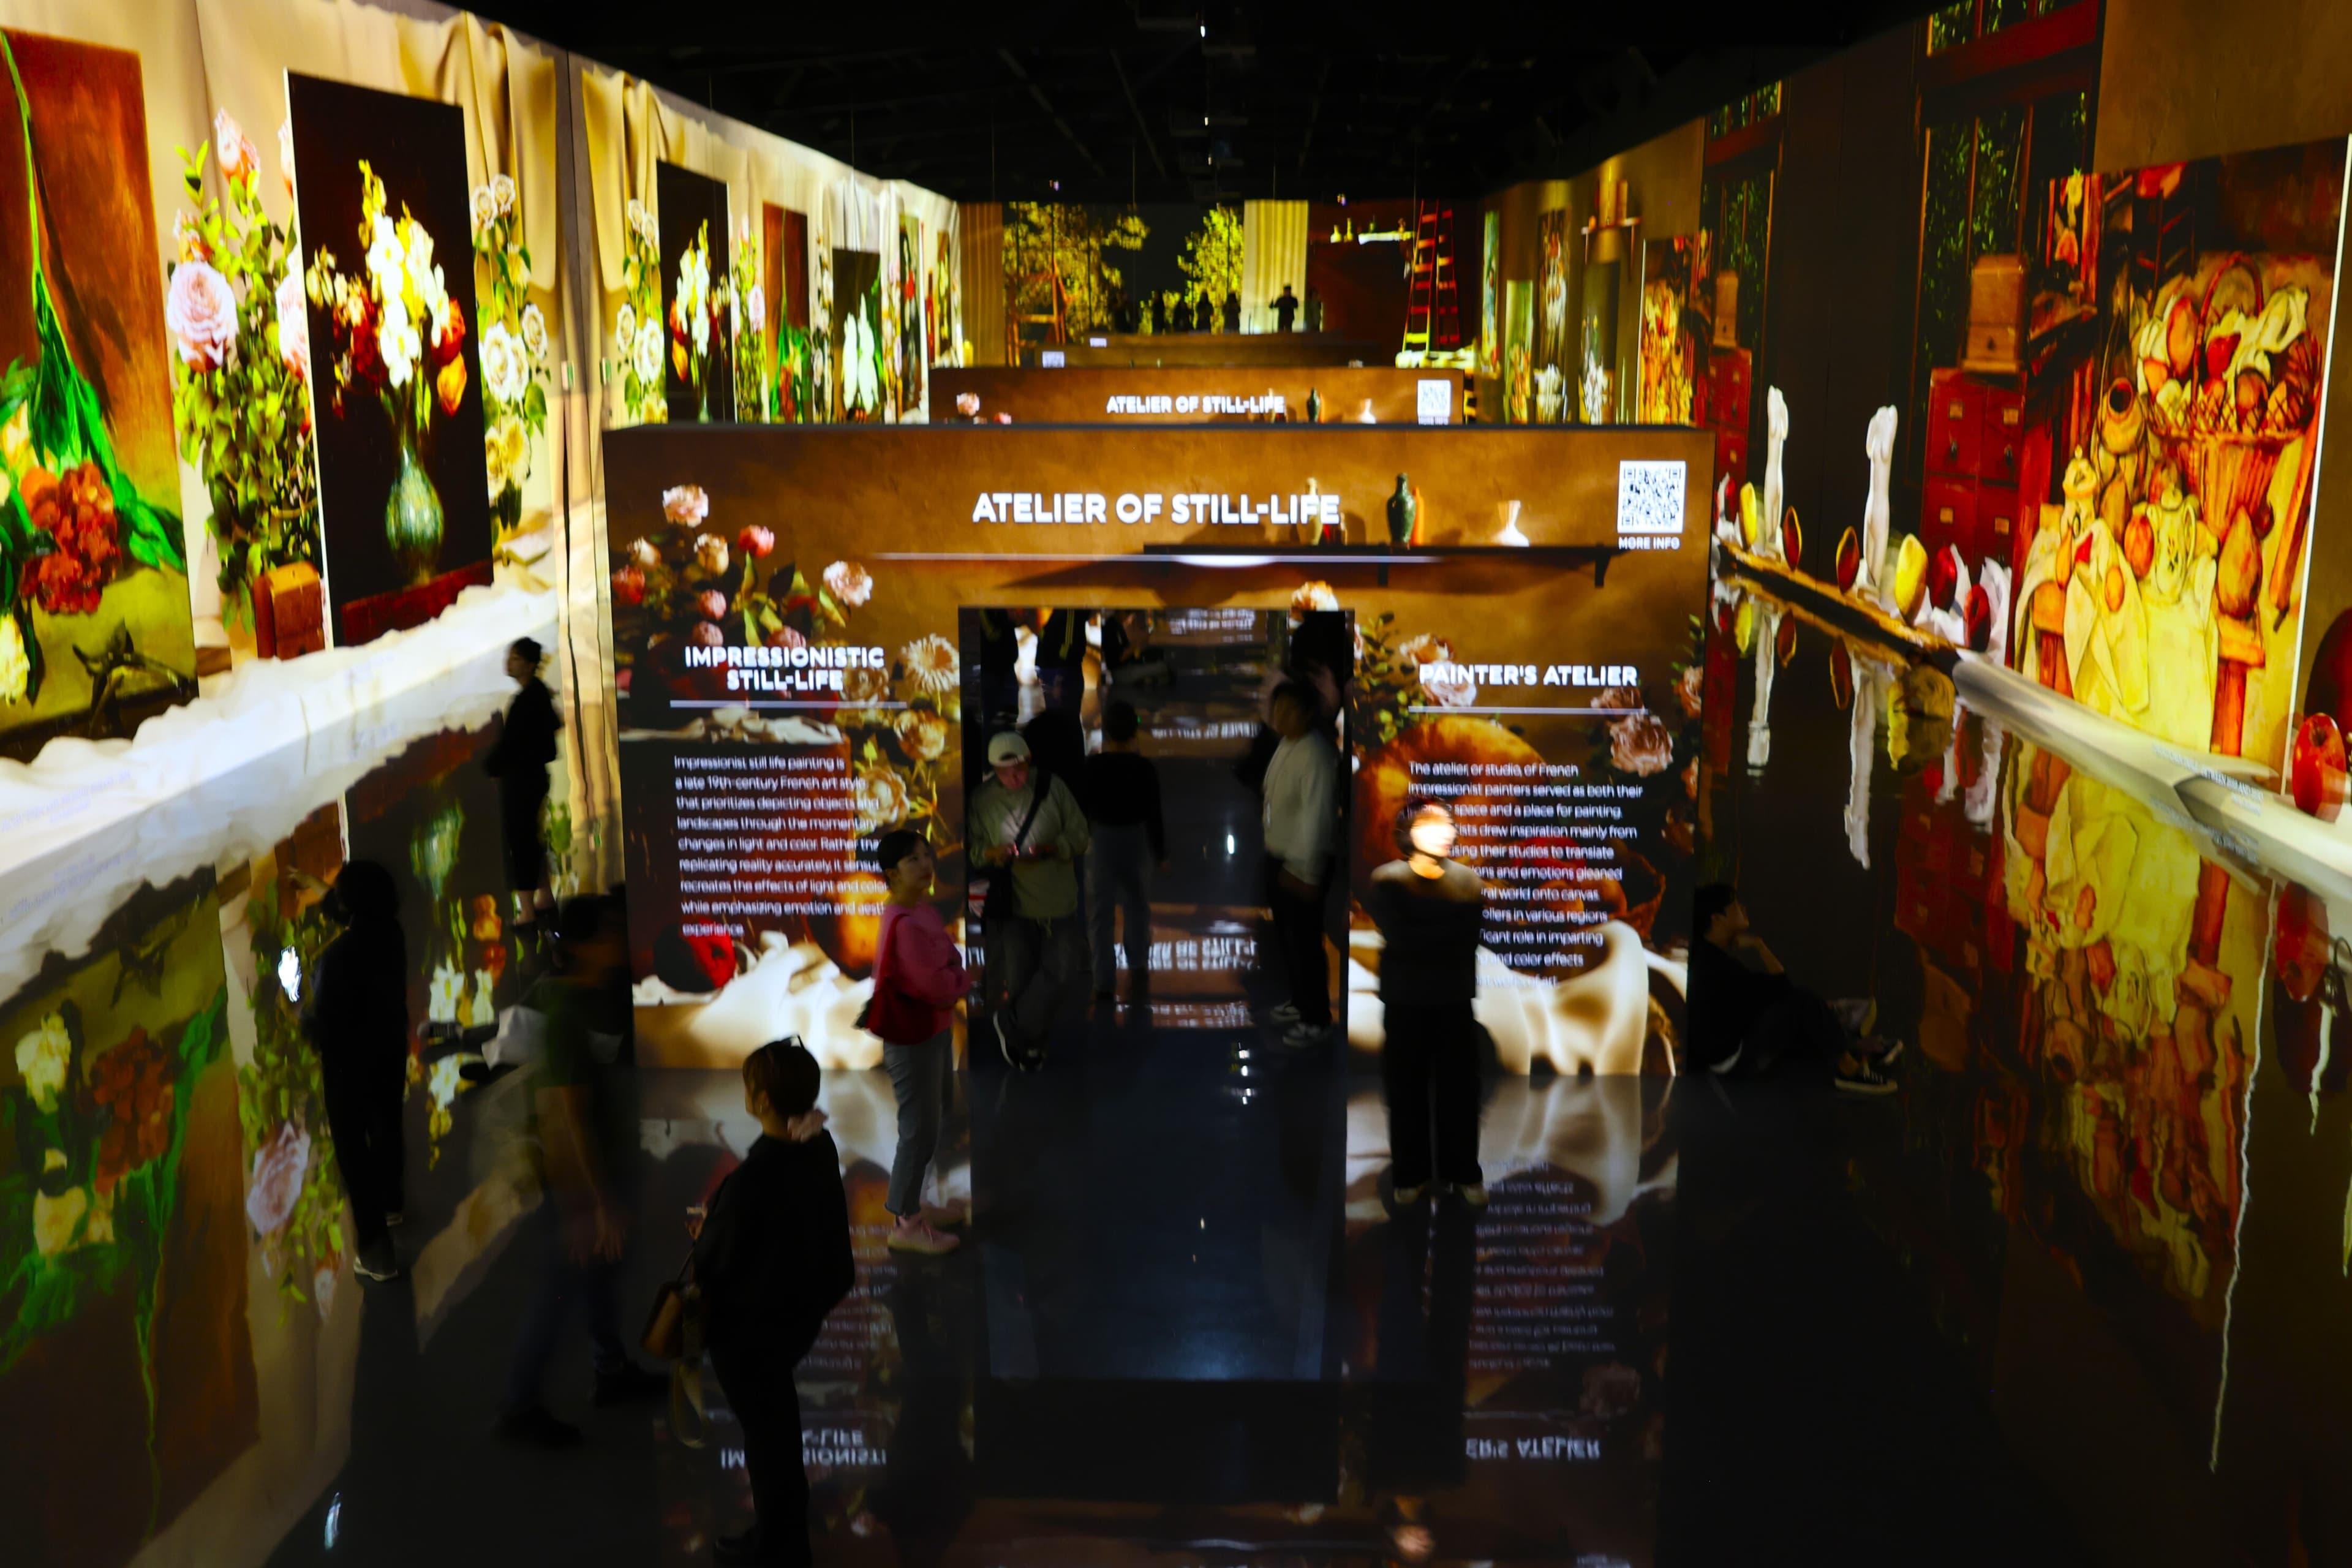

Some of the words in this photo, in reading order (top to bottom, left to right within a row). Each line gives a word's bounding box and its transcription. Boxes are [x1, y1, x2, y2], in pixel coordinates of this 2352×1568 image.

[1106, 396, 1172, 414] ATELIER
[1175, 396, 1199, 414] OF
[1202, 396, 1284, 414] STILL-LIFE
[972, 492, 1107, 524] ATELIER
[1115, 493, 1163, 524] OF
[1171, 494, 1340, 524] STILL-LIFE
[1618, 537, 1651, 549] MORE
[1653, 537, 1680, 550] INFO
[685, 646, 884, 668] IMPRESSIONISTIC
[726, 669, 843, 691] STILL-LIFE
[1419, 664, 1537, 685] PAINTER'S
[1543, 665, 1638, 687] ATELIER
[674, 755, 746, 771] Impressionist
[749, 756, 767, 770] still
[769, 755, 786, 771] life
[788, 756, 834, 772] painting
[837, 756, 845, 771] is
[1410, 761, 1430, 776] The
[1471, 763, 1483, 777] or
[1524, 762, 1537, 777] of
[1539, 763, 1579, 777] French
[676, 777, 682, 790] a
[684, 775, 705, 790] late
[780, 775, 820, 791] French
[821, 776, 838, 791] art
[1409, 782, 1482, 796] Impressionist
[1485, 783, 1531, 797] painters
[1532, 783, 1570, 797] served
[1572, 785, 1585, 797] as
[1587, 783, 1615, 797] both
[1616, 783, 1643, 798] their
[676, 795, 699, 810] that
[701, 796, 756, 811] prioritizes
[757, 796, 812, 812] depicting
[813, 796, 855, 812] objects
[857, 797, 880, 810] and
[1455, 804, 1488, 818] space
[1490, 802, 1512, 817] and
[1514, 805, 1521, 818] a
[1523, 803, 1554, 818] place
[1556, 803, 1573, 818] for
[677, 815, 739, 832] landscapes
[741, 816, 786, 832] through
[788, 816, 807, 831] the
[810, 816, 877, 832] momentary
[1479, 823, 1508, 837] drew
[1510, 823, 1568, 839] inspiration
[1570, 824, 1607, 841] mainly
[1609, 824, 1638, 839] from
[678, 836, 725, 853] changes
[727, 836, 737, 850] in
[739, 836, 764, 853] light
[766, 837, 788, 851] and
[821, 837, 857, 851] Rather
[861, 837, 881, 851] tha
[1480, 844, 1507, 858] their
[1509, 844, 1549, 859] studios
[1551, 845, 1563, 859] to
[1566, 845, 1615, 860] translate
[679, 857, 737, 874] replicating
[739, 858, 773, 874] reality
[834, 859, 841, 872] it
[1496, 865, 1518, 880] and
[1520, 865, 1574, 880] emotions
[1576, 866, 1623, 882] gleaned
[680, 879, 731, 894] recreates
[734, 879, 753, 894] the
[755, 878, 794, 894] effects
[796, 879, 808, 894] of
[810, 879, 834, 896] light
[837, 880, 858, 894] and
[1499, 887, 1530, 901] world
[1532, 887, 1559, 901] onto
[681, 899, 710, 914] while
[712, 900, 782, 917] emphasizing
[784, 900, 832, 915] emotion
[834, 901, 855, 915] and
[1514, 908, 1524, 922] in
[1525, 908, 1564, 922] various
[1567, 909, 1608, 925] regions
[1513, 930, 1534, 944] role
[1537, 930, 1547, 944] in
[1548, 930, 1604, 947] imparting
[1513, 952, 1542, 967] color
[1544, 952, 1584, 967] effects
